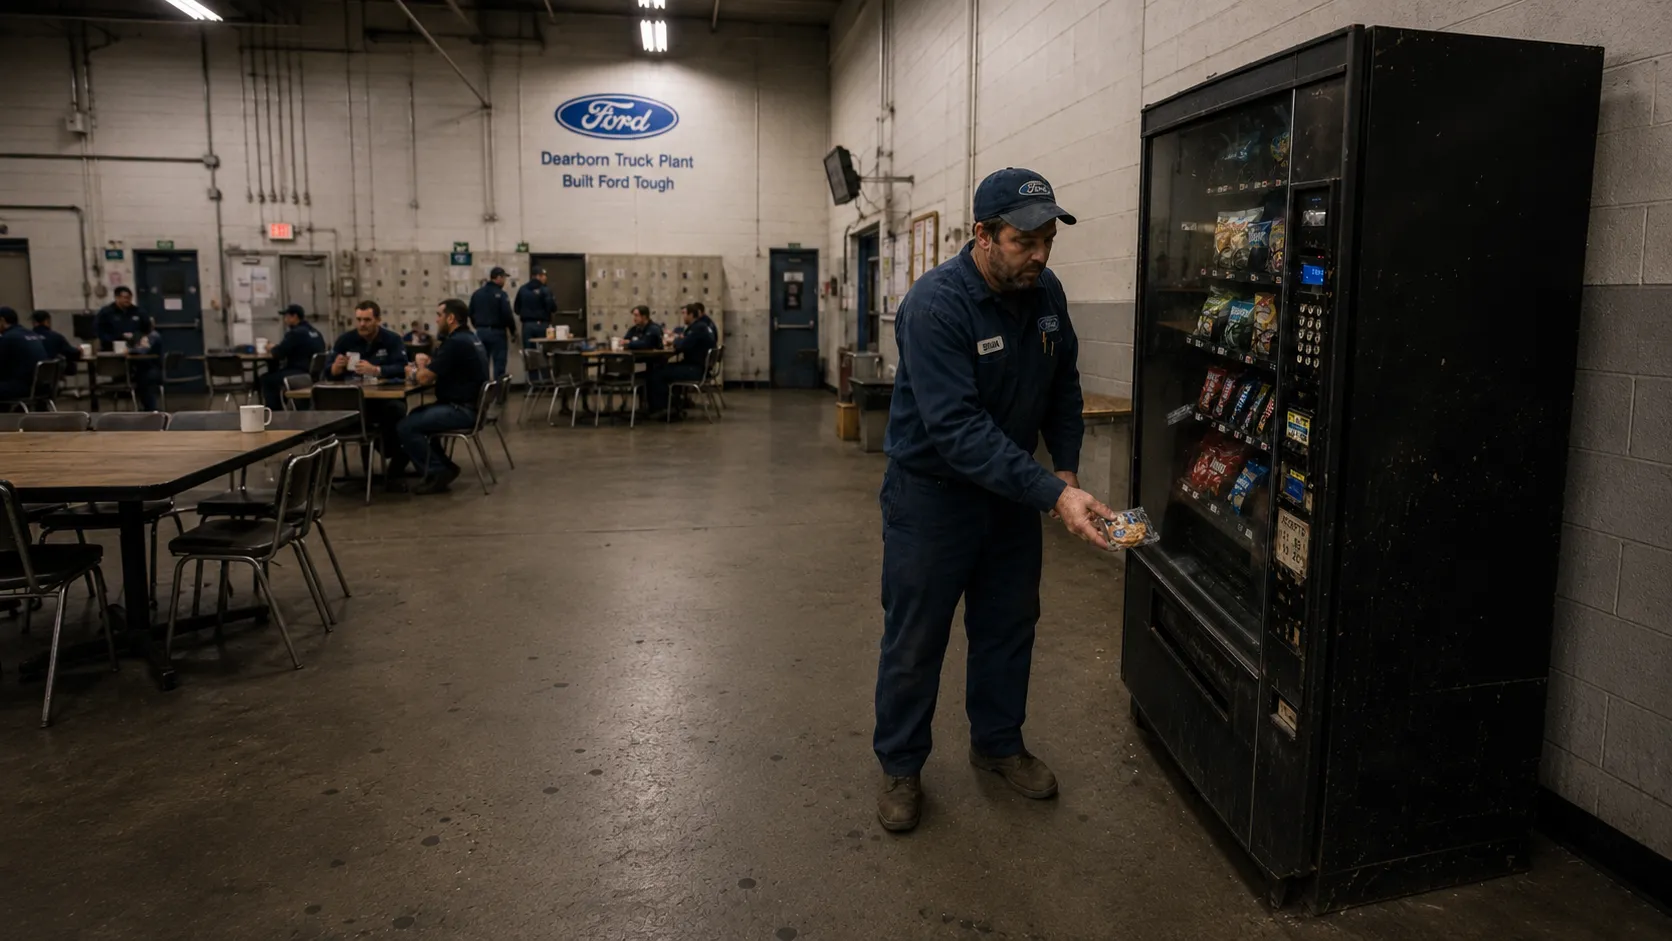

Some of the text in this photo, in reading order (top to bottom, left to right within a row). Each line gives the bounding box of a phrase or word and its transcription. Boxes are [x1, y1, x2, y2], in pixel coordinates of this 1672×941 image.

[581, 100, 652, 131] Ford
[541, 151, 694, 169] Dearborn Truck Plant
[562, 174, 674, 192] Built Ford Tough
